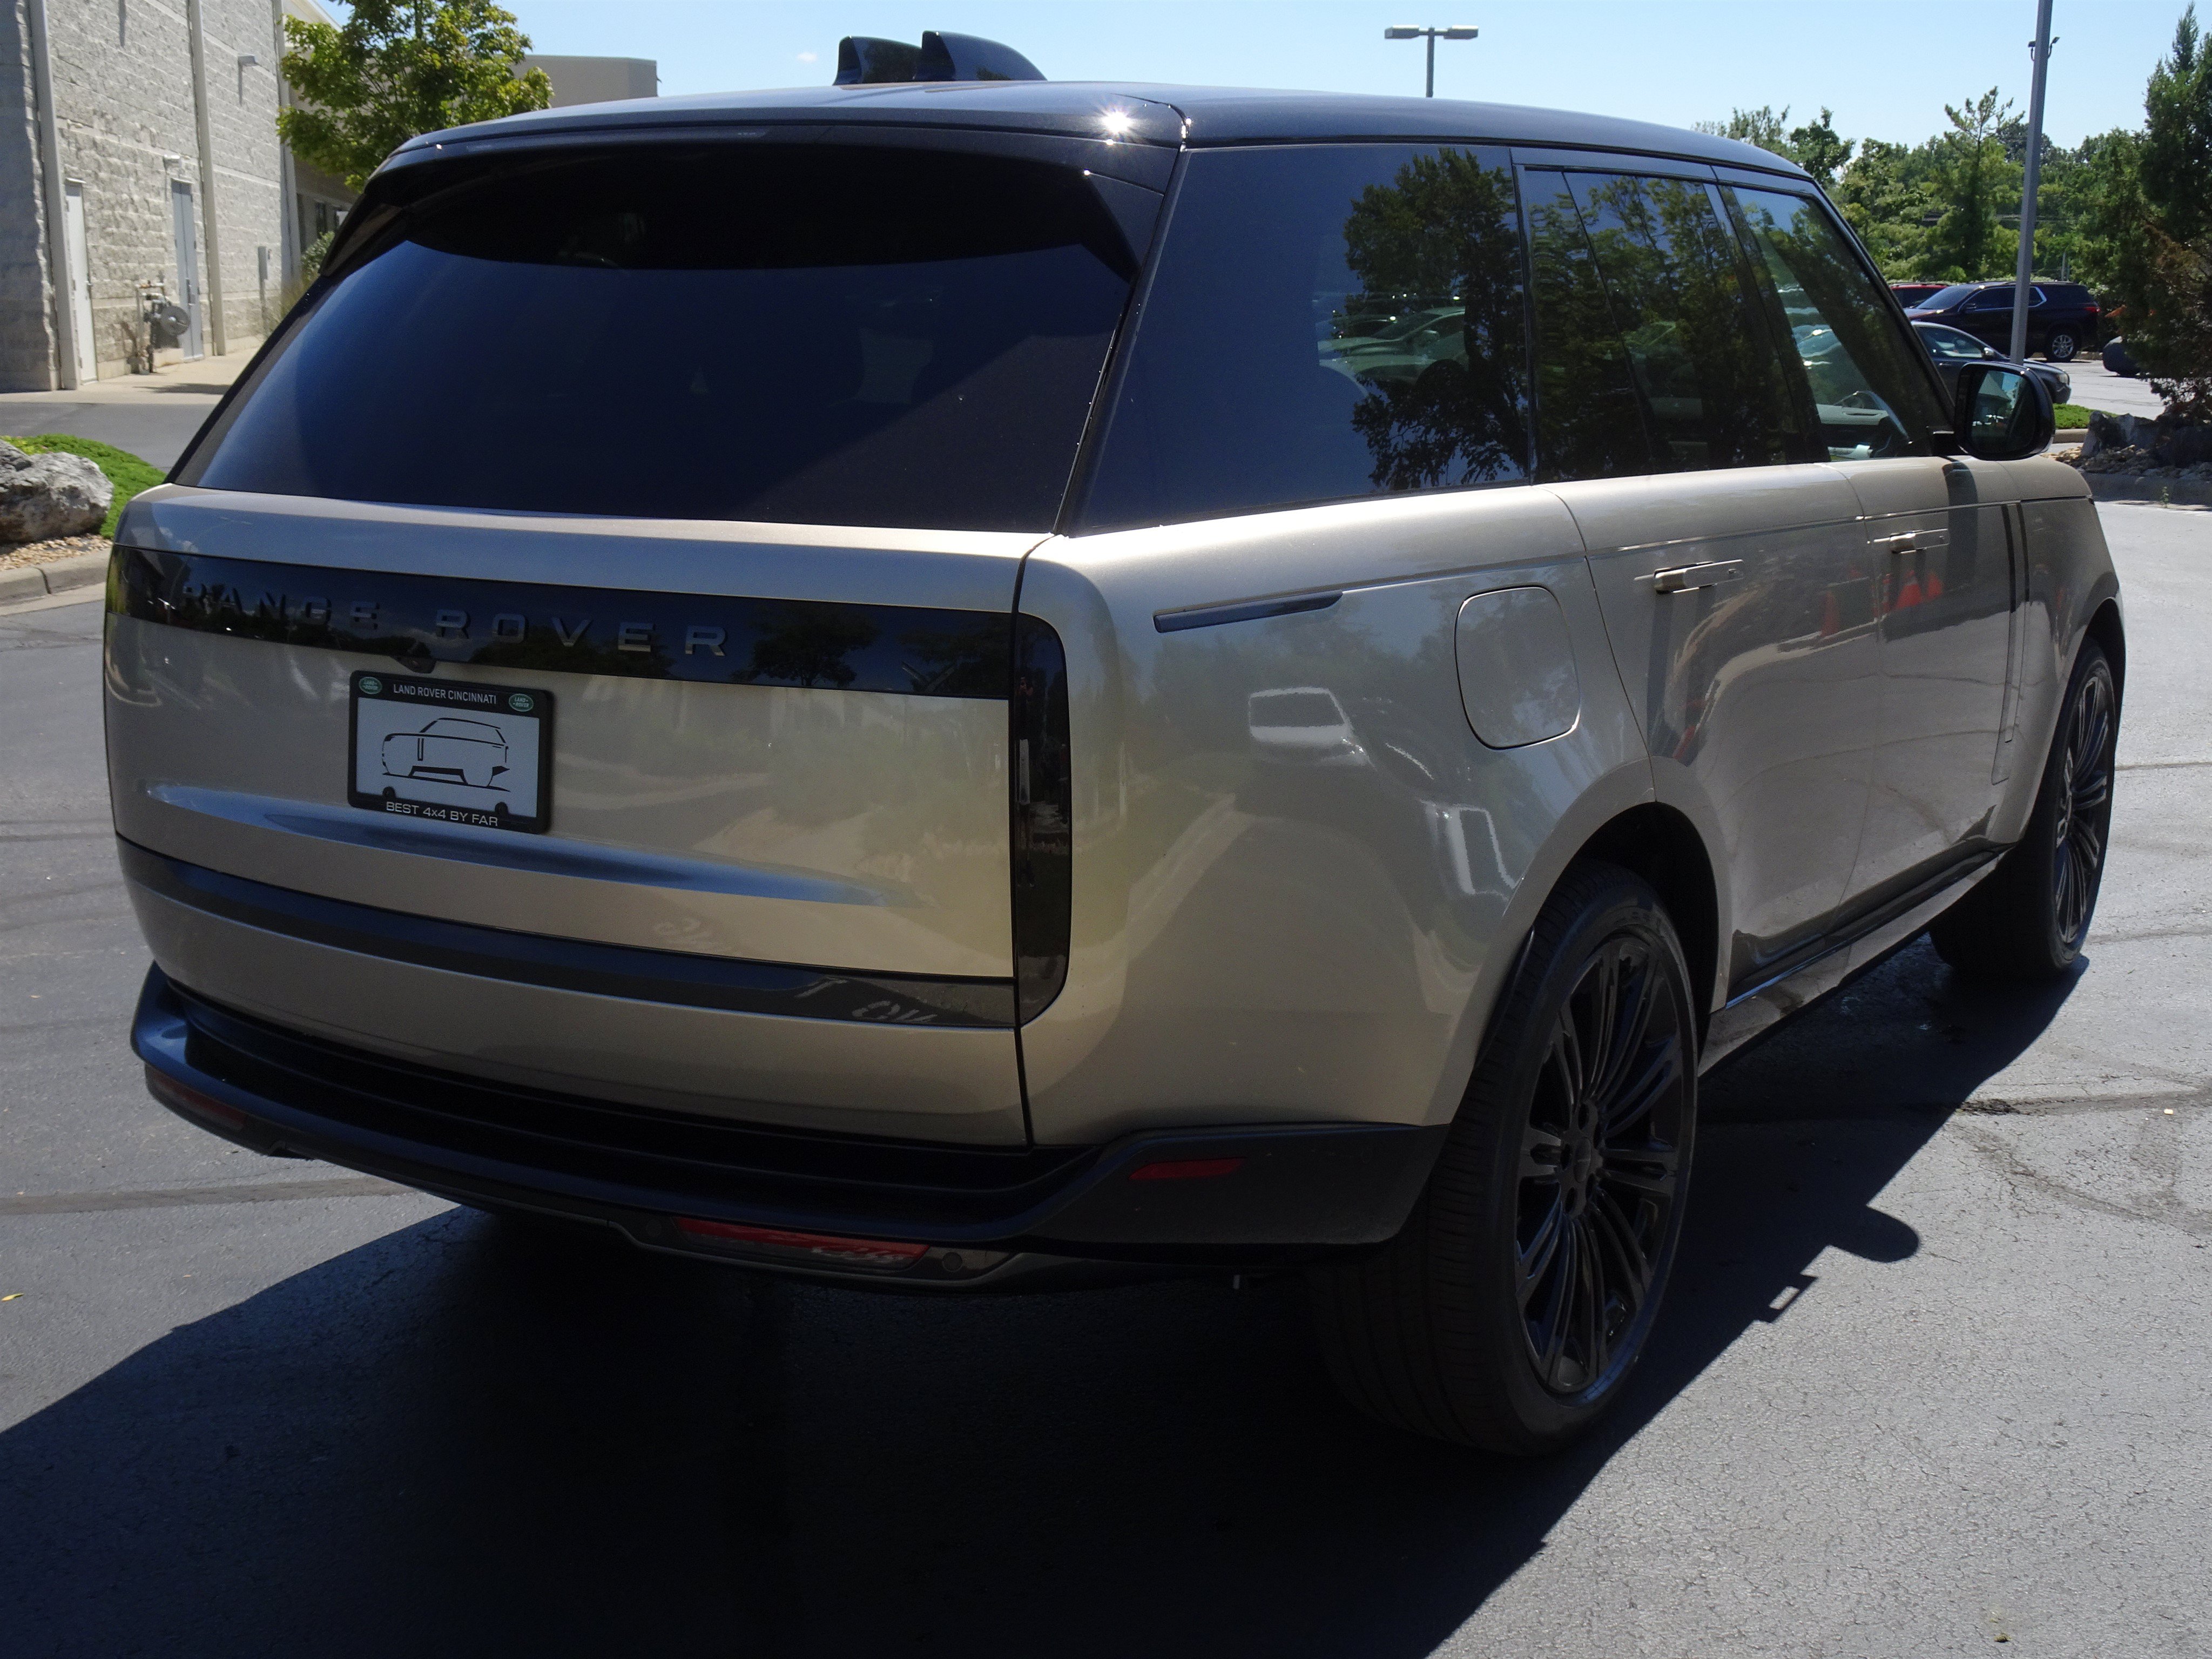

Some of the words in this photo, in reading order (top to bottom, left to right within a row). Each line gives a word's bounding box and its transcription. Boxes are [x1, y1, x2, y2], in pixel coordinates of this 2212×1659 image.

[182, 583, 380, 631] RANGE
[435, 609, 727, 656] ROVER
[393, 684, 416, 695] LAND
[417, 687, 447, 699] ROVER
[448, 691, 496, 704] CINCINNATI
[386, 801, 420, 814] BEST
[423, 807, 446, 819] 4x4
[450, 811, 468, 821] BY
[471, 814, 498, 826] FAR
